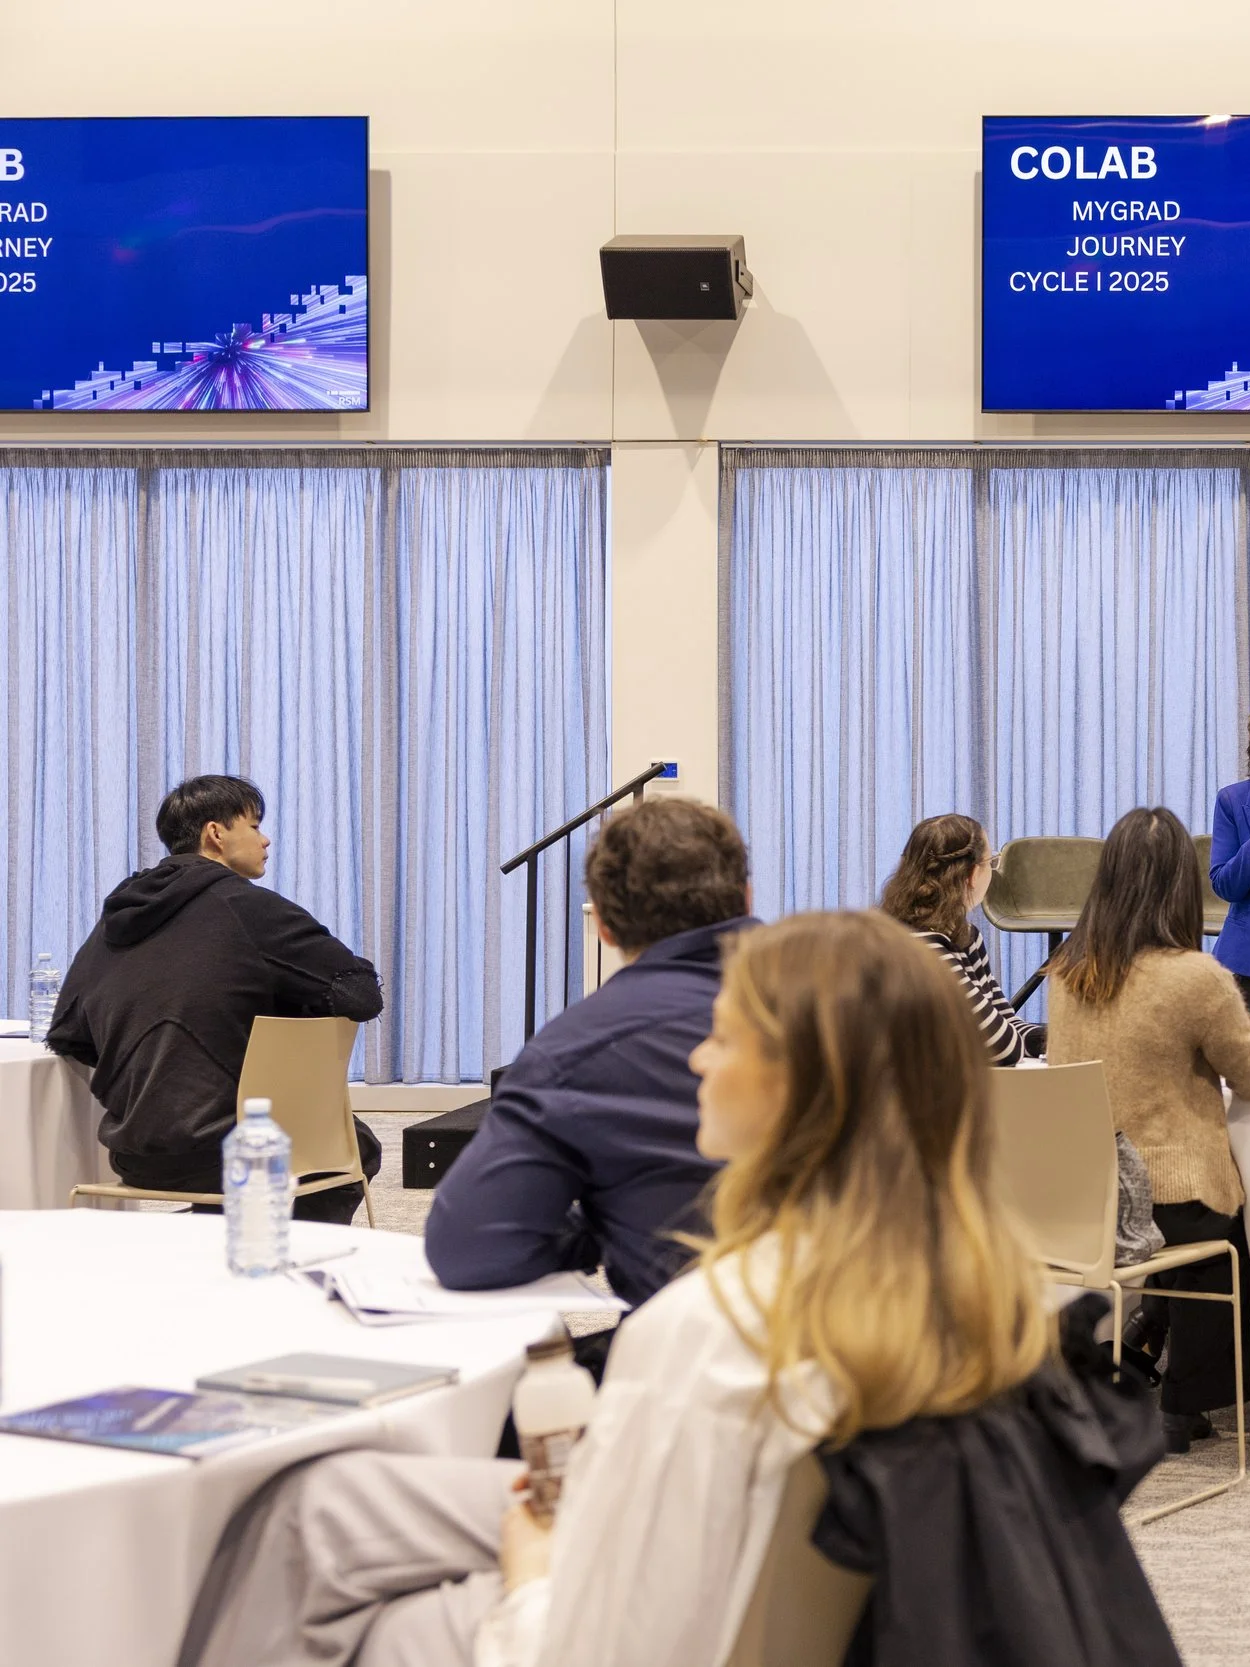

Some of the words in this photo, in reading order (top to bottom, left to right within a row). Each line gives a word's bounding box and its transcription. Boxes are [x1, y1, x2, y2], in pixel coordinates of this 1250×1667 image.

[1010, 145, 1157, 180] COLAB
[1073, 200, 1181, 221] MYGRAD
[0, 237, 53, 258] NEY
[1066, 236, 1186, 257] JOURNEY
[1009, 271, 1089, 292] CYCLE
[1109, 271, 1169, 292] 2025
[338, 396, 361, 406] RSM
